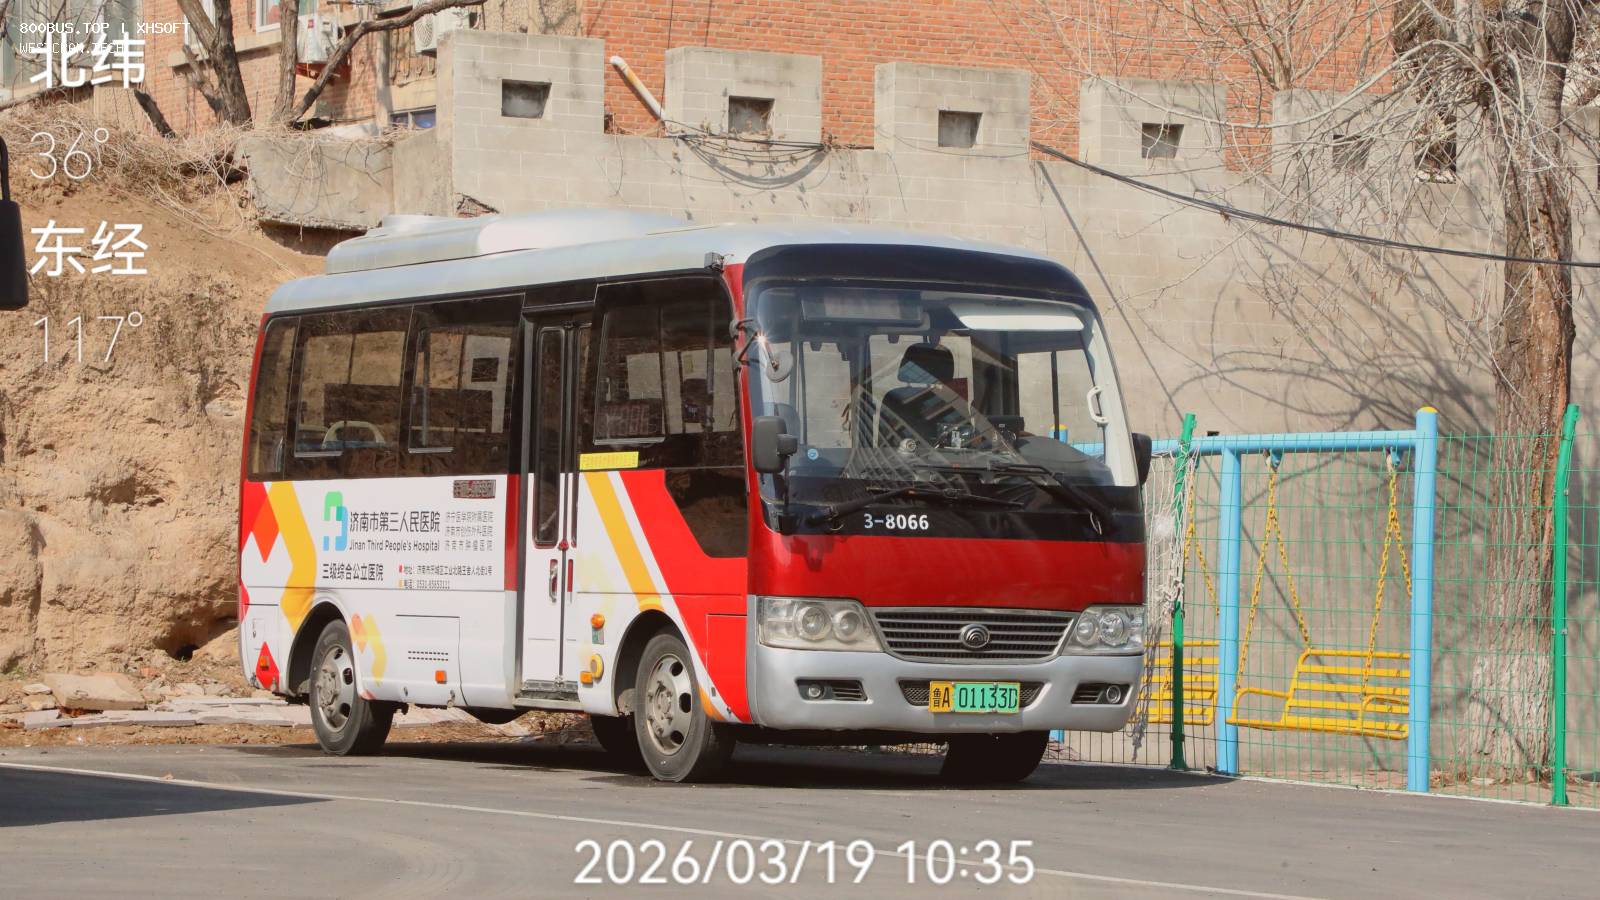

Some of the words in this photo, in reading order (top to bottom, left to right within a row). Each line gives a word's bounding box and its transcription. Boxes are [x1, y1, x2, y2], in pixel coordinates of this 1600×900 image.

[349, 511, 441, 533] 济南市第三人民医院
[863, 513, 930, 531] 3-8066
[349, 539, 366, 551] Jinan
[367, 539, 384, 551] Third
[385, 539, 412, 553] People's
[413, 539, 440, 554] Hospital
[321, 563, 384, 582] 三级综合公立医院
[932, 686, 951, 708] 鲁A
[958, 686, 1019, 709] 01133D
